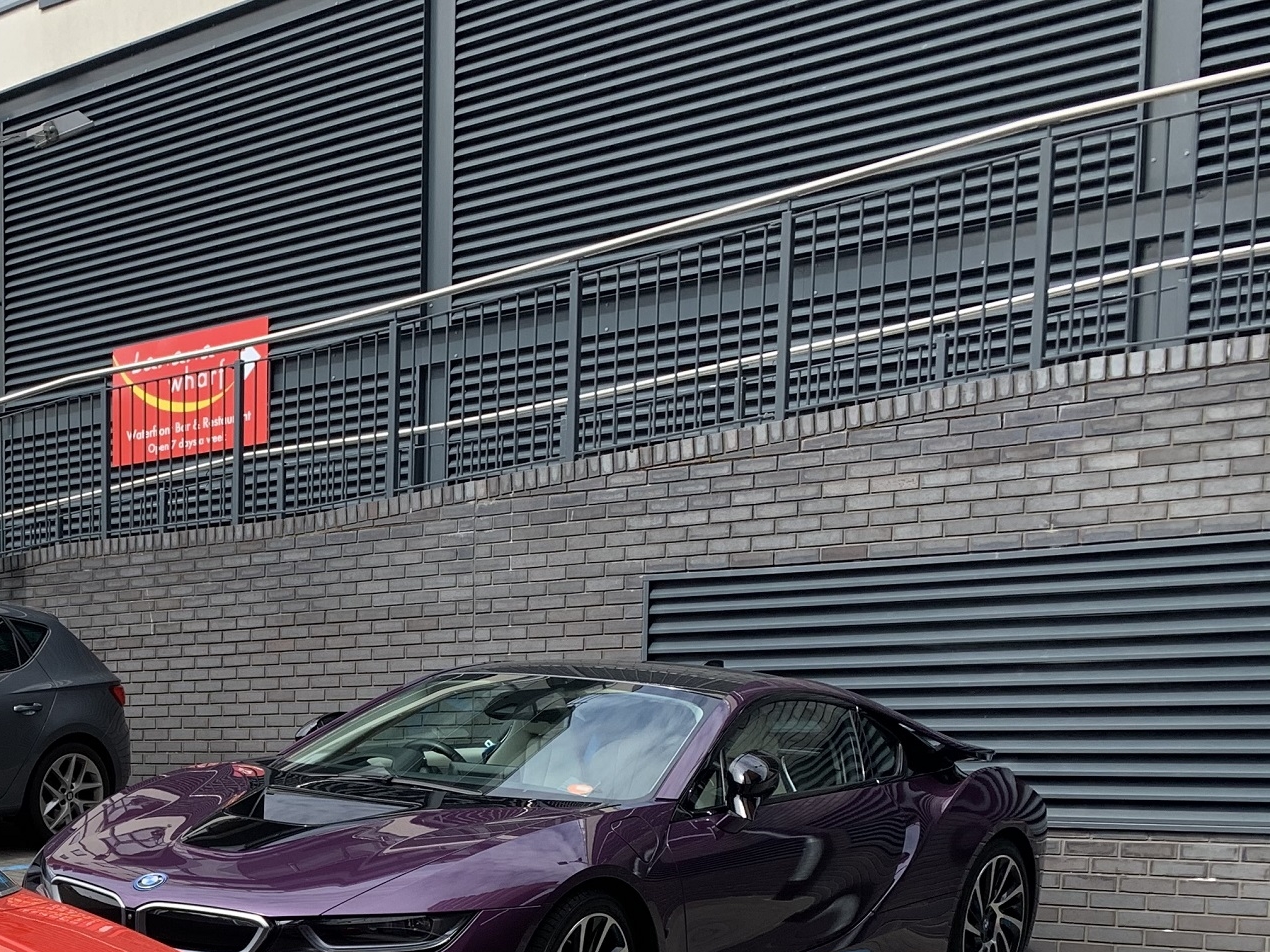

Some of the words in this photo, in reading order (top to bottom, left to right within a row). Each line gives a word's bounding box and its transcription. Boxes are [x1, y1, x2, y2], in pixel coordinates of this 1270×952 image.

[167, 358, 226, 393] wharf
[126, 424, 173, 442] Waterfron
[175, 421, 191, 434] Bar
[202, 411, 252, 429] Restaurnt
[171, 440, 178, 450] 7
